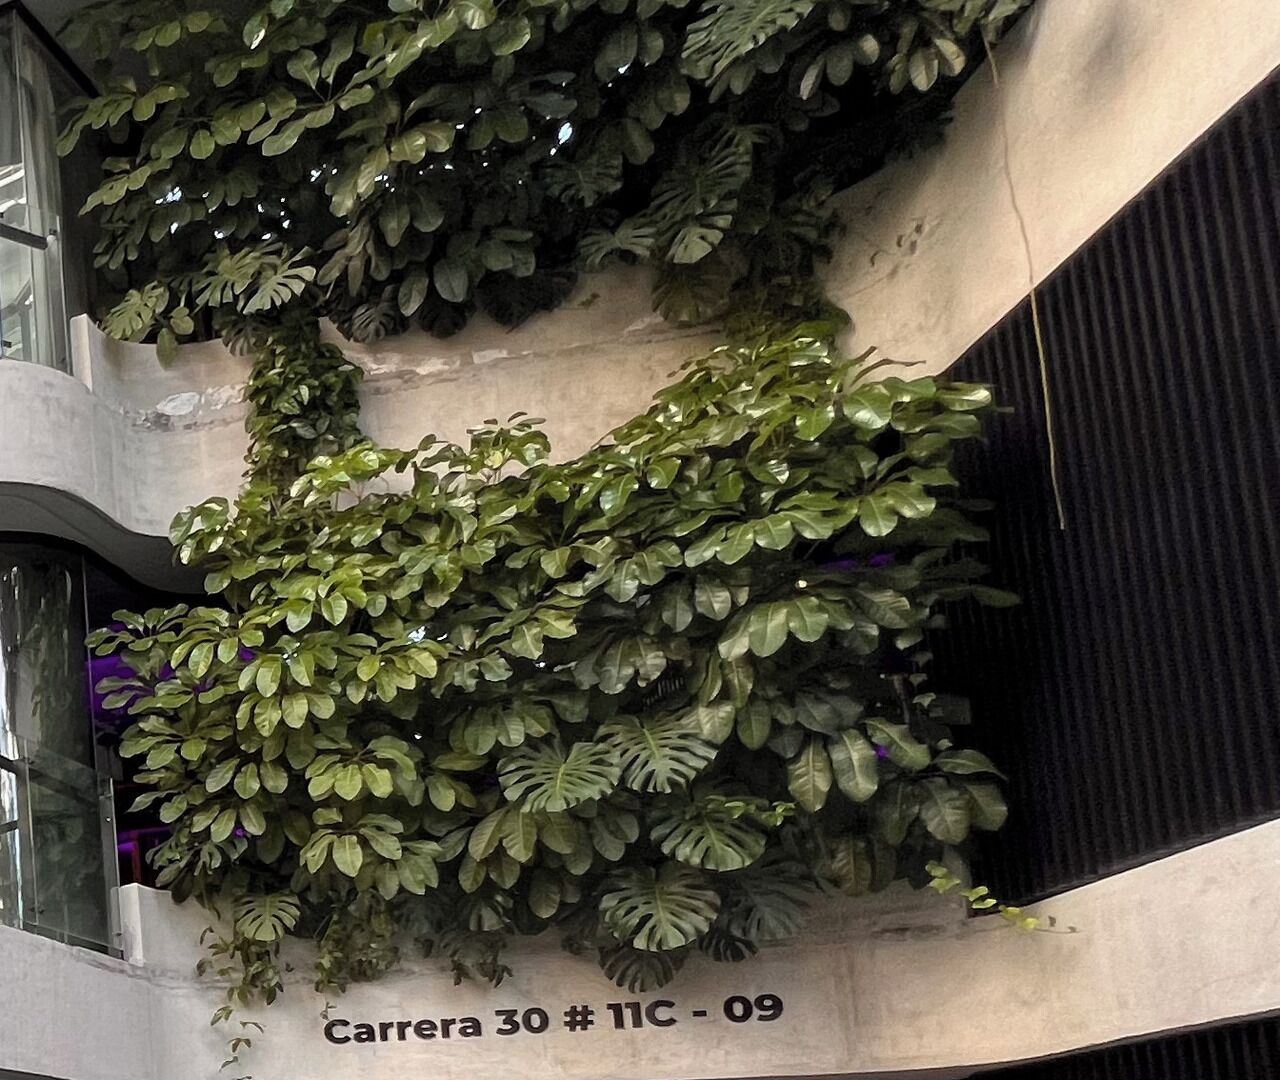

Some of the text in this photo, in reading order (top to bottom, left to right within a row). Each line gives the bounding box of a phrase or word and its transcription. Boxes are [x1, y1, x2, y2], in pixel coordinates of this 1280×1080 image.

[323, 1015, 483, 1045] Carrera
[494, 1007, 550, 1036] 30
[563, 1004, 595, 1032] #
[606, 999, 678, 1030] 11C
[723, 993, 784, 1024] 09
